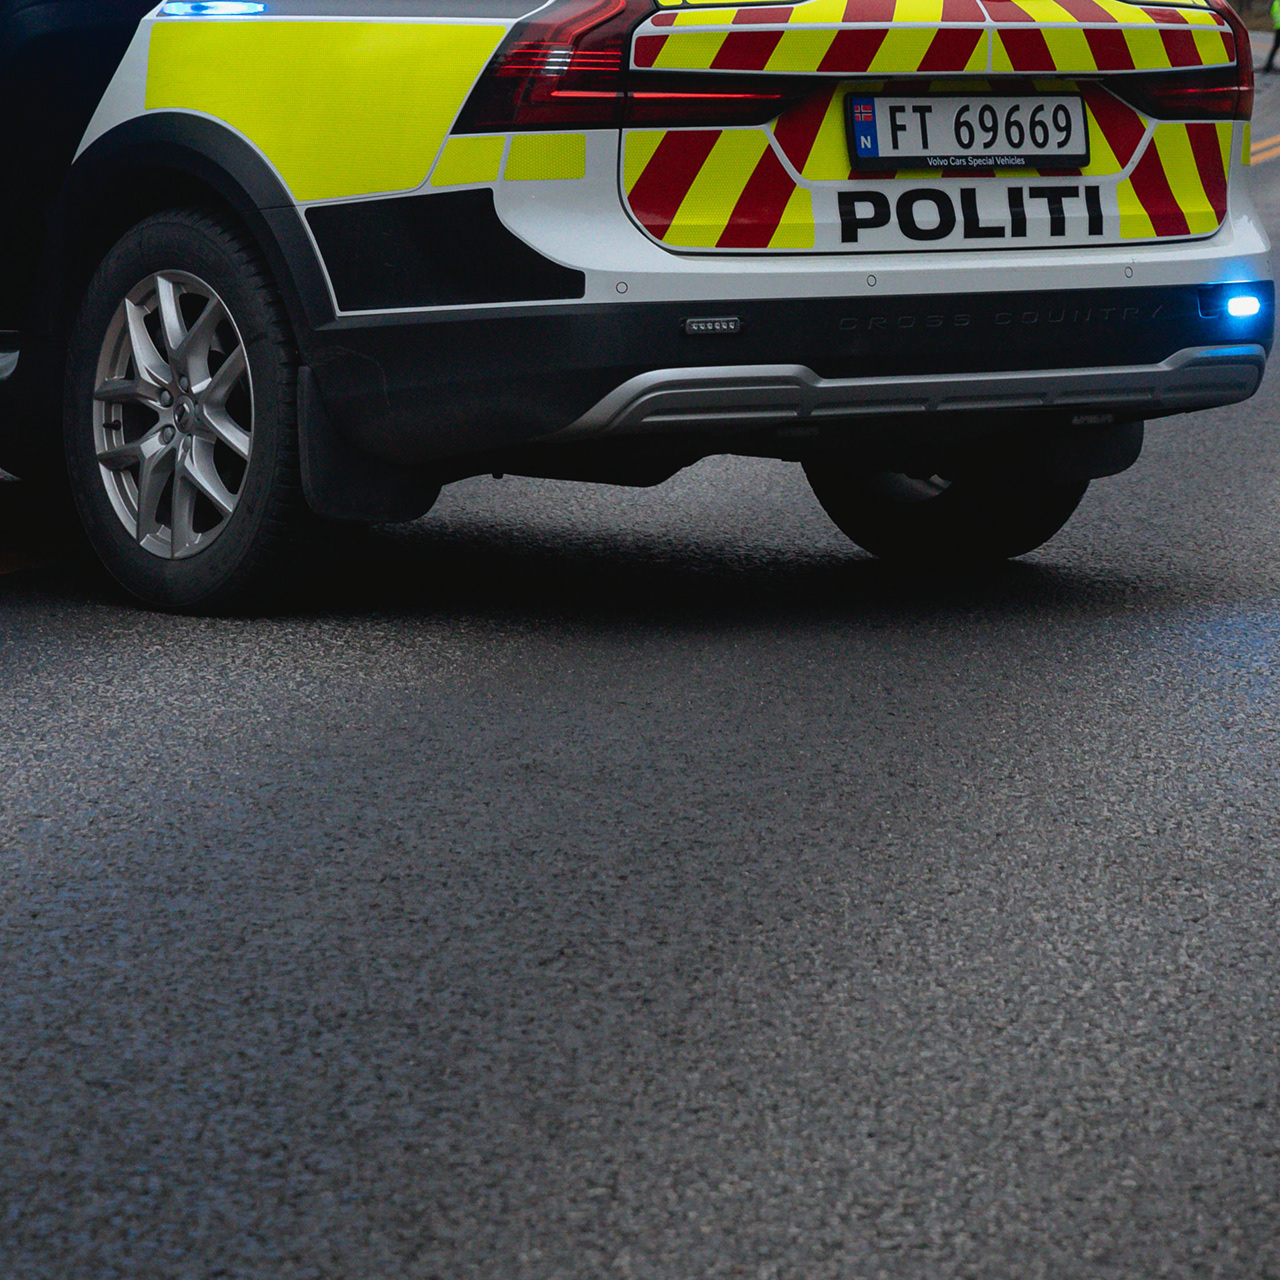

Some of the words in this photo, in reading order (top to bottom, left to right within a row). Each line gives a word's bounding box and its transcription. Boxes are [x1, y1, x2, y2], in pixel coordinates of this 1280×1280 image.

[888, 105, 933, 150] FT
[953, 103, 1072, 150] 69669
[861, 135, 872, 149] N
[927, 156, 948, 166] Volvo
[949, 156, 967, 166] Cars
[967, 156, 995, 167] Special
[995, 155, 1026, 165] Vehicles
[837, 185, 1104, 244] POLITI
[838, 312, 972, 331] CROSS
